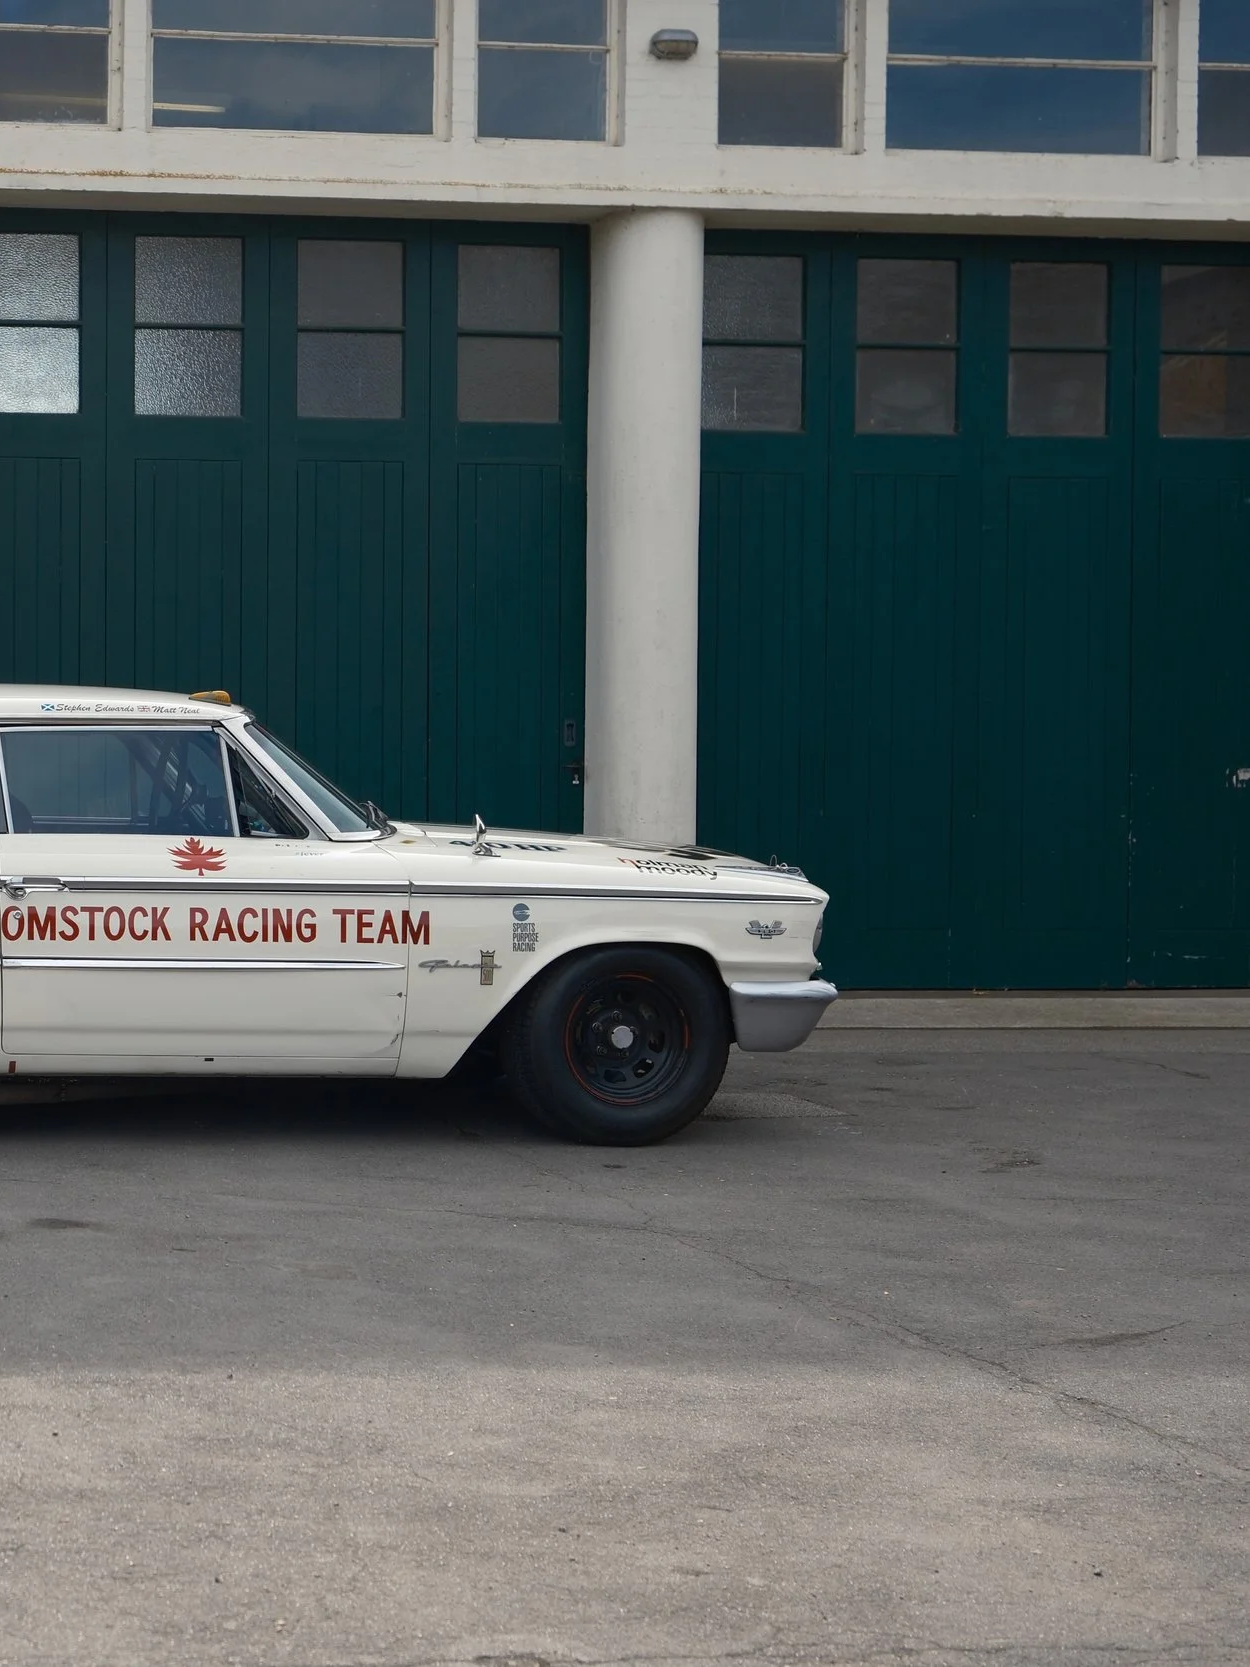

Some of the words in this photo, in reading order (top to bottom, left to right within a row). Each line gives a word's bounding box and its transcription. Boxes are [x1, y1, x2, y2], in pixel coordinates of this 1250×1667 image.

[55, 703, 91, 713] Stephen
[94, 703, 135, 713] Edwards
[151, 705, 177, 714] Matt
[178, 706, 200, 714] Neal
[616, 857, 708, 870] holman
[636, 865, 718, 881] moody
[189, 907, 317, 943] RACING
[332, 908, 430, 945] TEAM
[512, 923, 536, 933] SPORTS
[512, 932, 539, 943] PURPOSE
[512, 942, 536, 953] RACING
